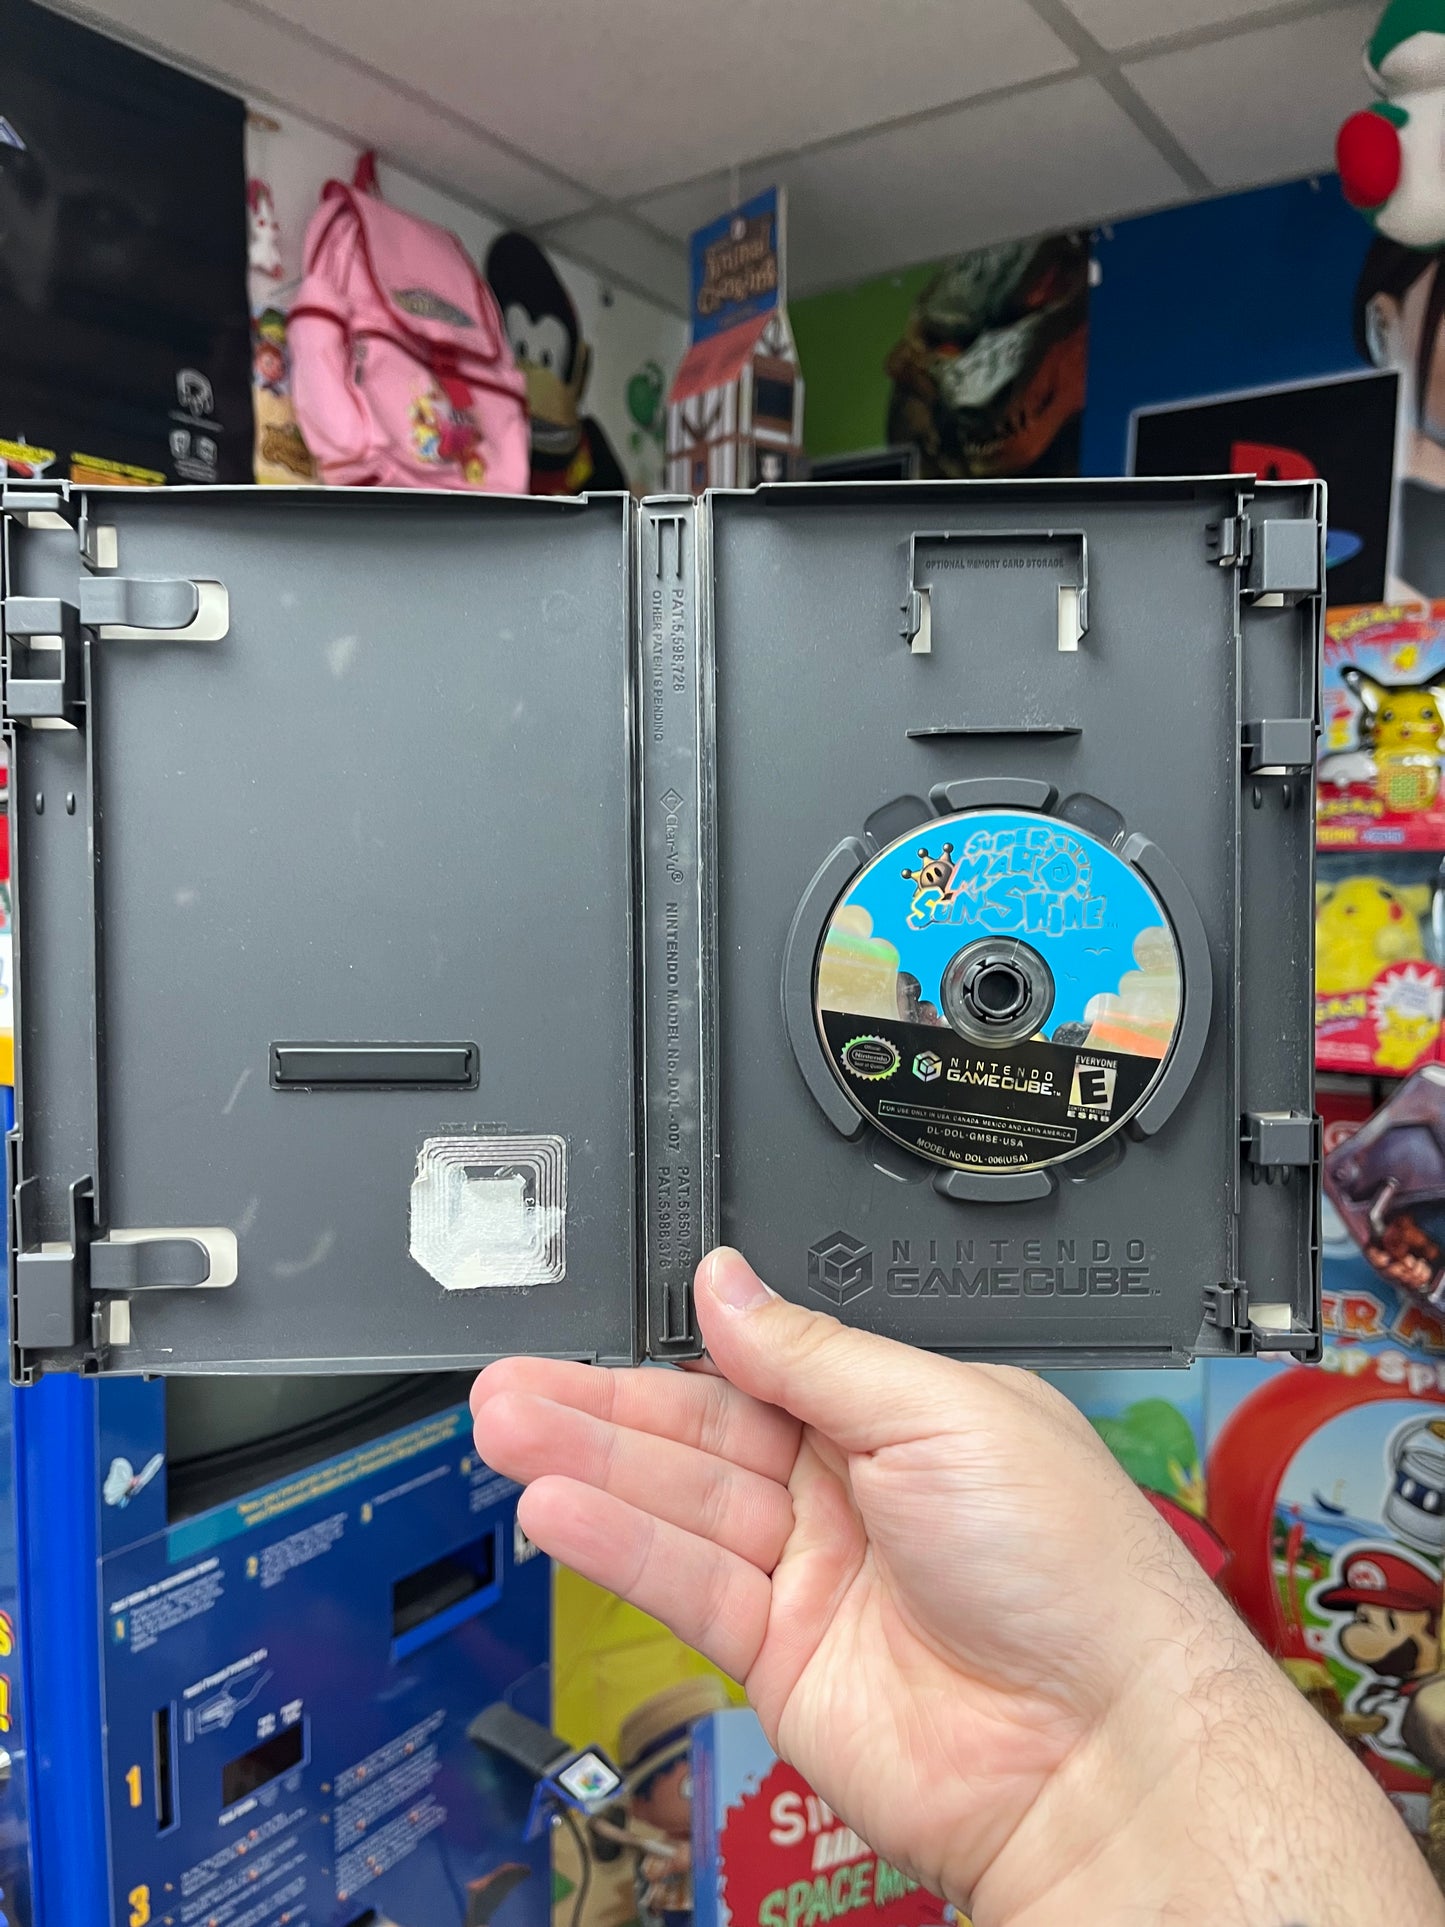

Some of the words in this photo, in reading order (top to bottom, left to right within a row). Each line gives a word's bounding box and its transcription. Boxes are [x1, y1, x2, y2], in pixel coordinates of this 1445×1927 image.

[926, 560, 965, 569] OPTIONAL
[967, 559, 1000, 569] MEMORY
[1002, 559, 1024, 568] CARD
[1026, 559, 1064, 568] STORAGE
[652, 590, 663, 630] OTHER
[652, 634, 663, 687] PATENTS
[653, 689, 664, 742] PENDING
[965, 827, 1053, 855] SUPER
[945, 841, 1084, 893] MARIO
[666, 902, 679, 987] NINTENDO
[667, 989, 679, 1046] MODEL
[855, 1051, 888, 1062] Nintendo
[951, 1057, 1053, 1081] NINTENDO
[1075, 1054, 1118, 1069] EVERYONE
[947, 1069, 1053, 1096] GAMECUBE
[1079, 1070, 1108, 1105] E
[897, 1106, 909, 1114] USE
[982, 1119, 1007, 1129] MEXICO
[1008, 1123, 1021, 1131] AND
[1023, 1126, 1041, 1134] LATIN
[1042, 1128, 1071, 1138] AMERICA
[1067, 1110, 1110, 1122] ESRB
[916, 1137, 947, 1156] MODEL
[891, 1239, 1146, 1264] NINTENDO
[886, 1267, 1151, 1298] GAMECUBE
[125, 1765, 142, 1808] 1
[758, 1859, 874, 1927] SPACE
